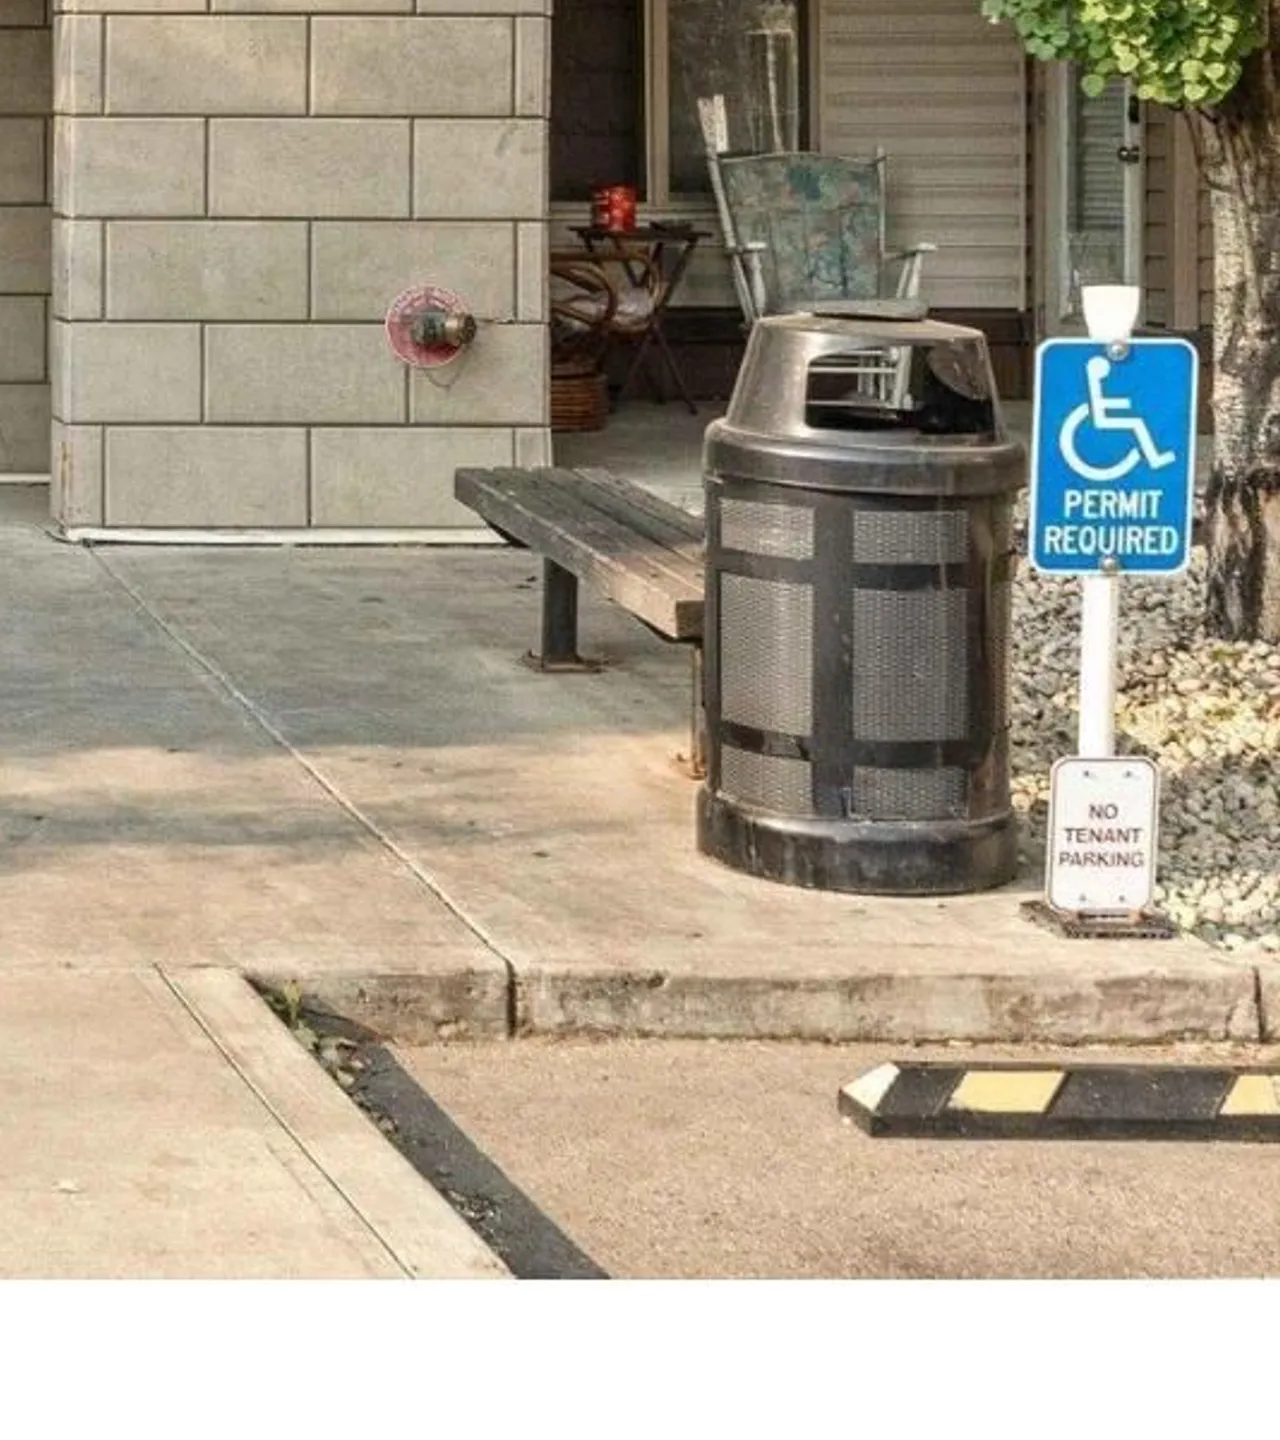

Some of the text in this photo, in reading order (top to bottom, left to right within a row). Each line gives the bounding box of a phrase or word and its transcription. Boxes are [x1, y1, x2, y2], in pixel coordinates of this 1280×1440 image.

[1064, 489, 1163, 519] PERMIT
[1044, 525, 1178, 555] REQUIRED
[1088, 803, 1119, 820] NO
[1063, 827, 1143, 843] TENANT
[1058, 851, 1145, 868] PARKING
